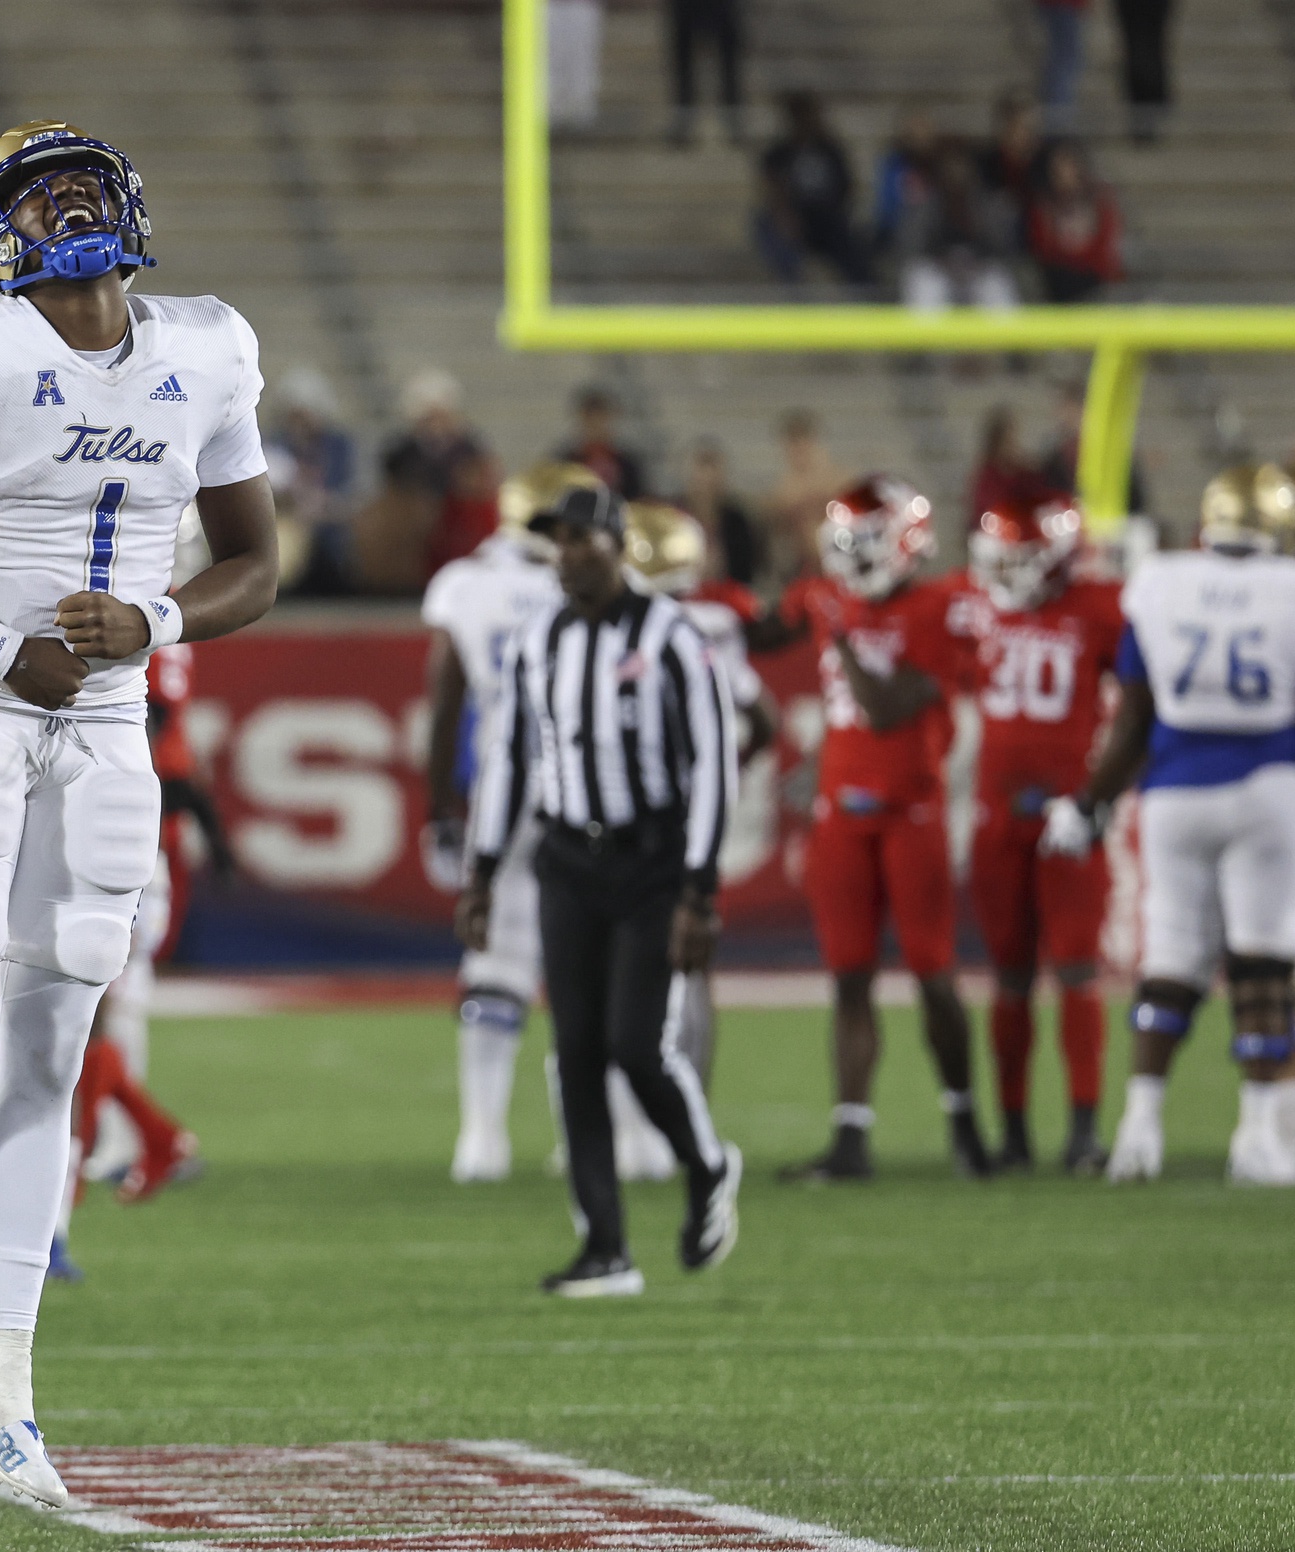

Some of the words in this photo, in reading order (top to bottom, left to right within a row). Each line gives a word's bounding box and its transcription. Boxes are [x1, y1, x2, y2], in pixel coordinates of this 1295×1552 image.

[72, 236, 103, 247] Riddell
[149, 391, 188, 402] adidas
[52, 422, 170, 465] Tulsa
[83, 477, 129, 592] 1
[148, 600, 165, 623] adidas
[1171, 622, 1271, 706] 76
